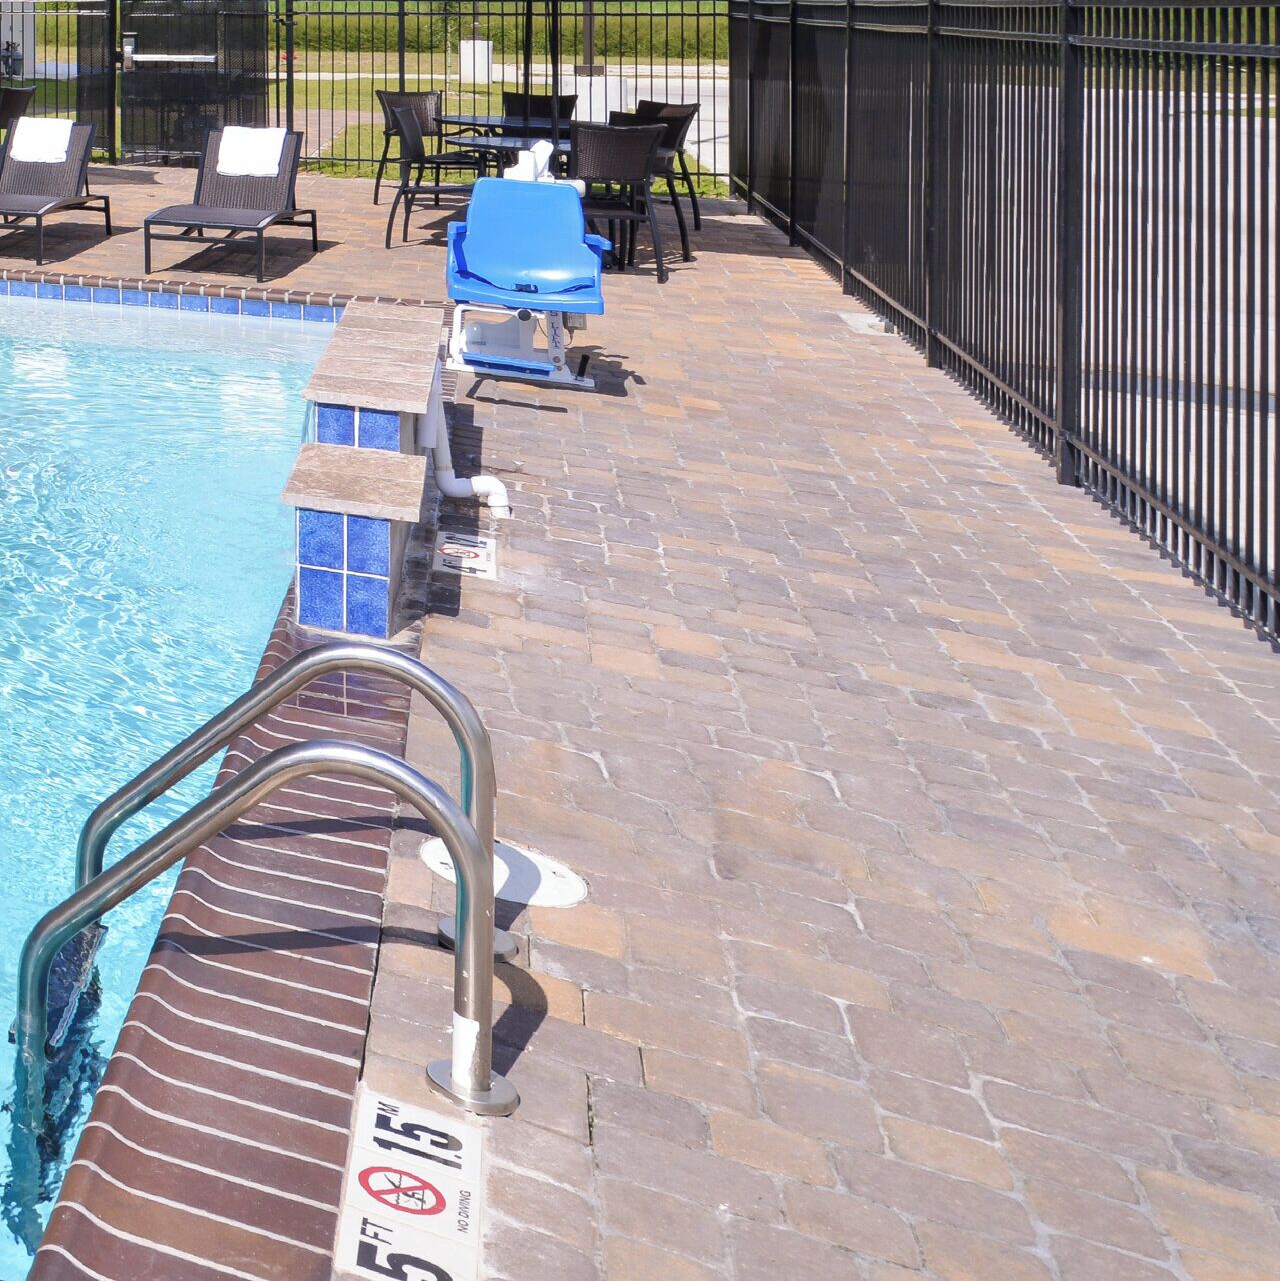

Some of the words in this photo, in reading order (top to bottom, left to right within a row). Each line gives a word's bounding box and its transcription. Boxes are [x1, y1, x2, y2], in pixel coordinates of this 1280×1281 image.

[376, 1100, 400, 1116] M
[458, 1189, 471, 1219] DIVING
[359, 1216, 394, 1245] FT
[456, 1219, 469, 1234] NO
